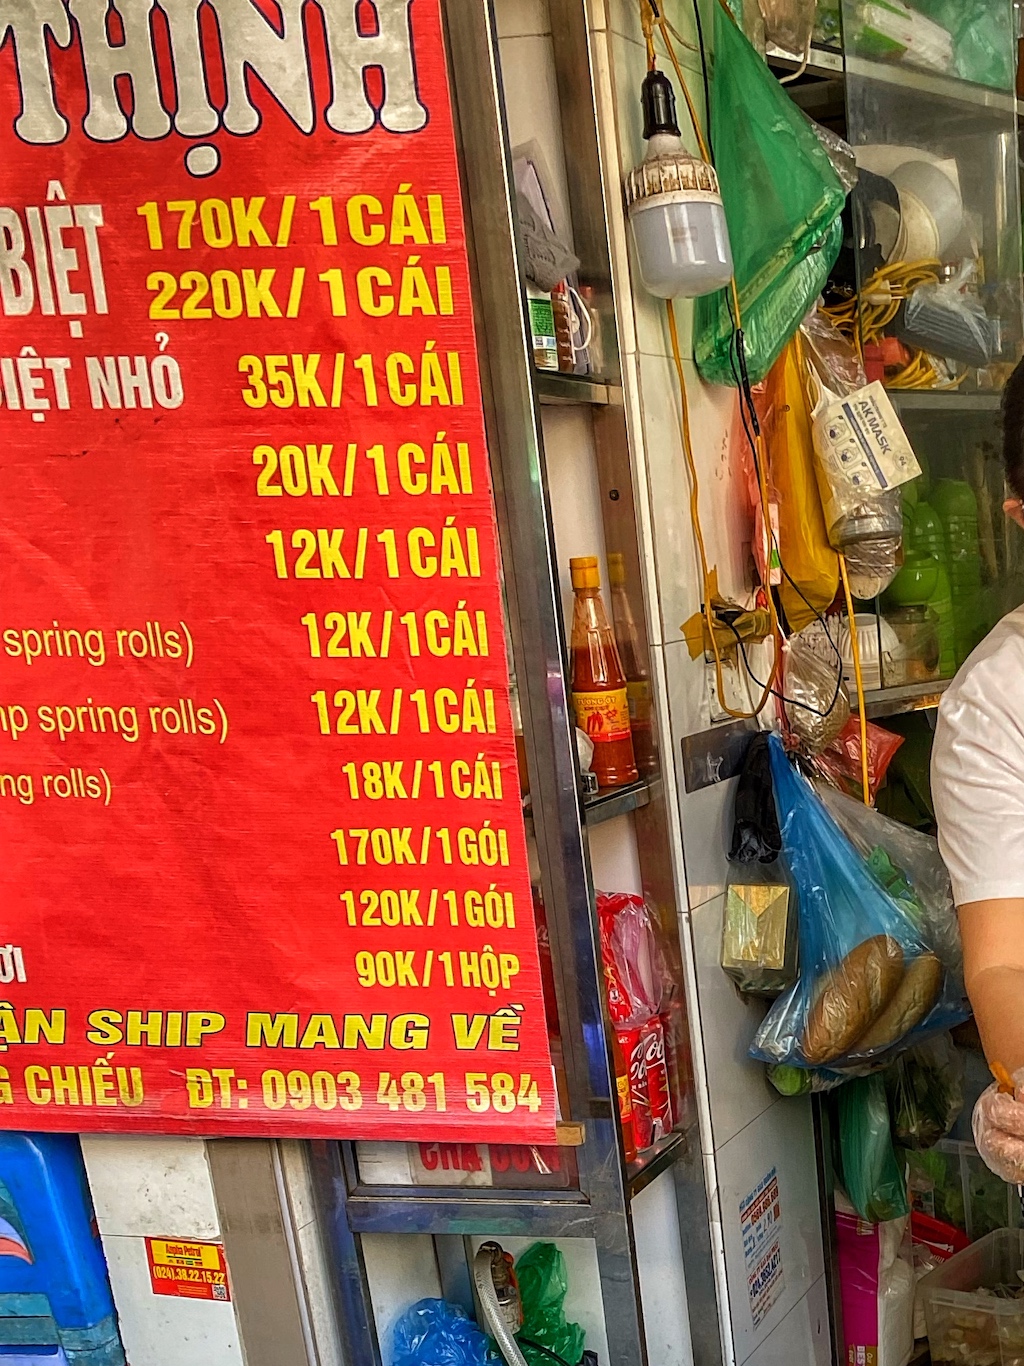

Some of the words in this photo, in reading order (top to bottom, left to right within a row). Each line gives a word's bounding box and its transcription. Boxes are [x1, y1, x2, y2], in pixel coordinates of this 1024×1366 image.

[0, 0, 429, 177] THỊNH
[0, 180, 109, 338] BIỆT
[85, 332, 184, 410] NHỎ
[867, 417, 892, 455] MASK
[3, 621, 106, 667] spring
[116, 620, 194, 668] rolls)
[37, 697, 140, 744] spring
[148, 698, 229, 744] rolls)
[42, 767, 112, 806] rolls)
[87, 1009, 225, 1047] SHIP
[246, 1012, 430, 1051] MANG
[453, 1003, 524, 1051] VỀ
[24, 1051, 144, 1108] CHIẾU
[186, 1068, 249, 1109] ĐT:
[261, 1069, 363, 1112] 0903
[376, 1071, 449, 1113] 481
[464, 1072, 542, 1113] 584
